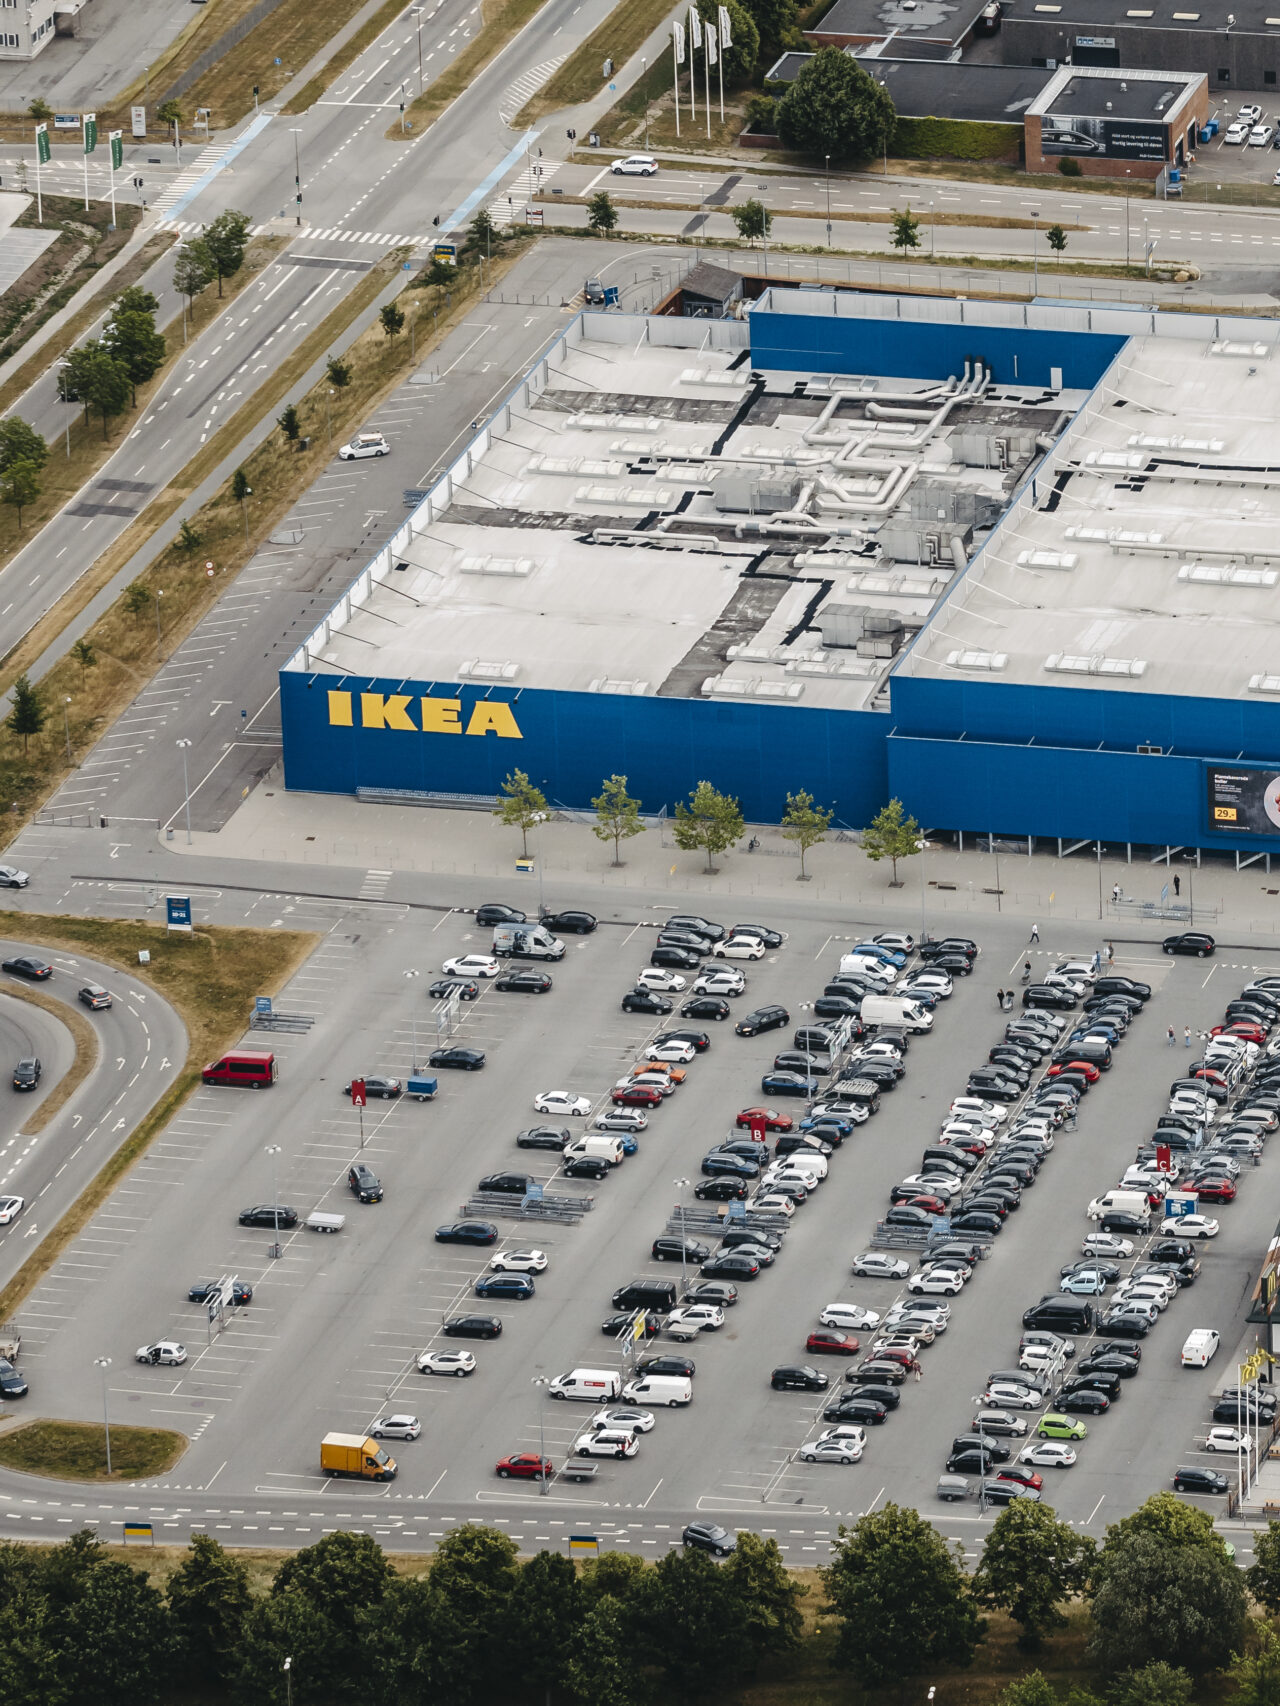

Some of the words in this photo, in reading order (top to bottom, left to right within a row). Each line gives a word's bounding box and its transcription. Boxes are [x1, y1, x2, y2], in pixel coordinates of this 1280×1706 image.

[327, 690, 524, 739] IKEA
[1217, 809, 1235, 818] 29.-
[355, 1095, 362, 1103] A
[754, 1130, 761, 1139] B
[1159, 1161, 1167, 1170] C
